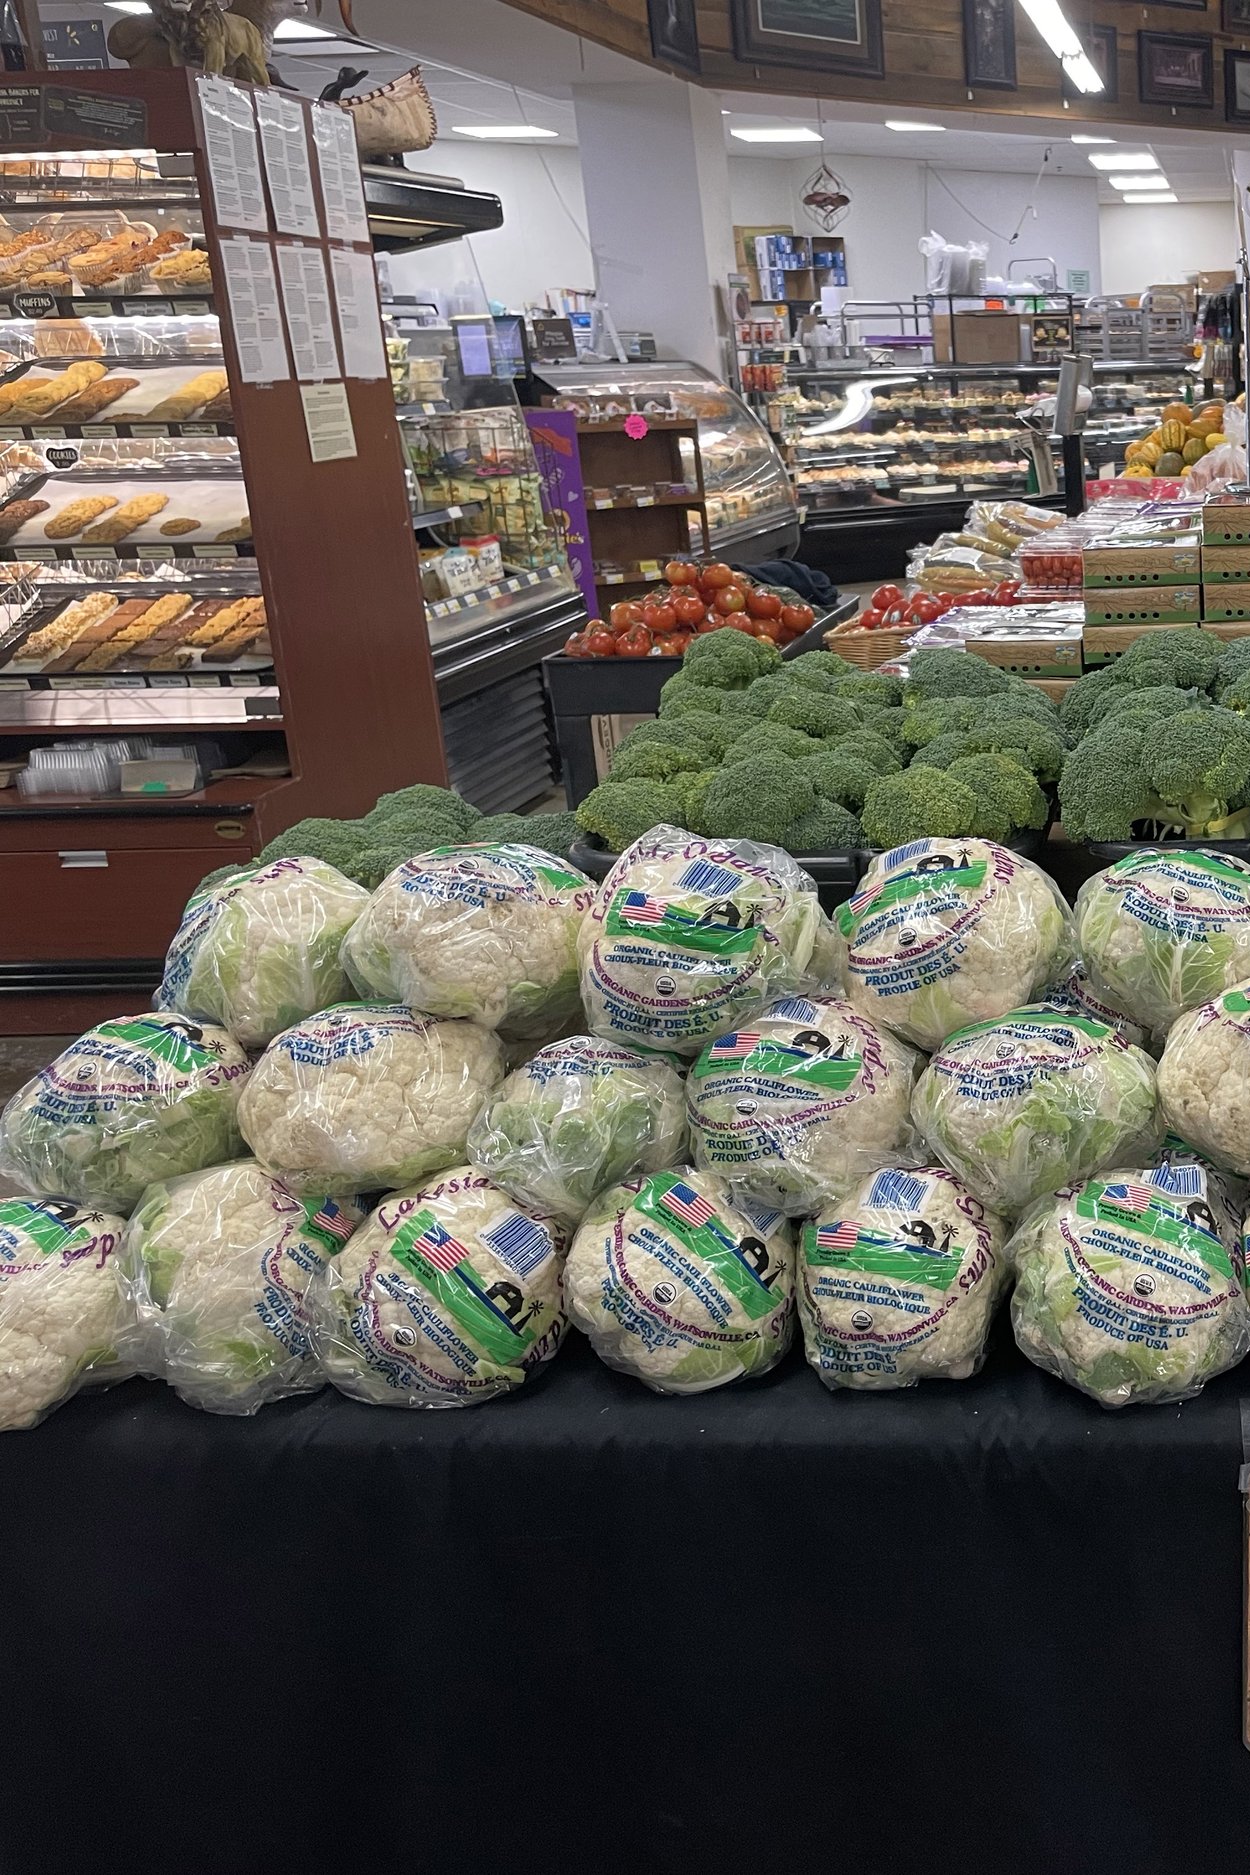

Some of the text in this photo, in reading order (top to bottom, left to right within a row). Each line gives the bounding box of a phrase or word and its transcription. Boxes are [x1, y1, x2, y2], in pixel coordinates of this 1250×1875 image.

[19, 298, 51, 307] MUFFINS
[1121, 901, 1169, 932] PRODUCE
[1213, 924, 1226, 933] U.
[614, 944, 656, 956] ORGANIC
[604, 955, 670, 968] CHOUX-FLEUR
[918, 960, 942, 975] DES
[924, 963, 962, 985] OF USA
[601, 974, 641, 1002] ORGANIC
[603, 1000, 662, 1028] PRODUIT
[664, 1017, 692, 1029] DES
[711, 1010, 724, 1022] U.
[667, 1027, 684, 1038] OF
[686, 1026, 711, 1038] USA
[704, 1076, 819, 1097] ORGANIC CAULIFLOWER
[104, 1101, 118, 1112] U.
[74, 1114, 97, 1125] USA
[640, 1227, 679, 1259] ORGANIC
[1080, 1236, 1154, 1267] CHOUX-FLEUR
[1092, 1228, 1211, 1282] ORGANIC CAULIFLOWER
[818, 1276, 852, 1289] ORGANIC
[867, 1295, 931, 1315] BIOLOGIQUE
[1072, 1286, 1189, 1338] PRODUIT DES É. U.
[1116, 1291, 1167, 1314] GARDENS,
[421, 1304, 480, 1366] CAULIFLOWER
[744, 1330, 761, 1341] CA
[1076, 1304, 1169, 1351] PRODUCE OF USA
[422, 1326, 477, 1378] BIOLOGIQUE
